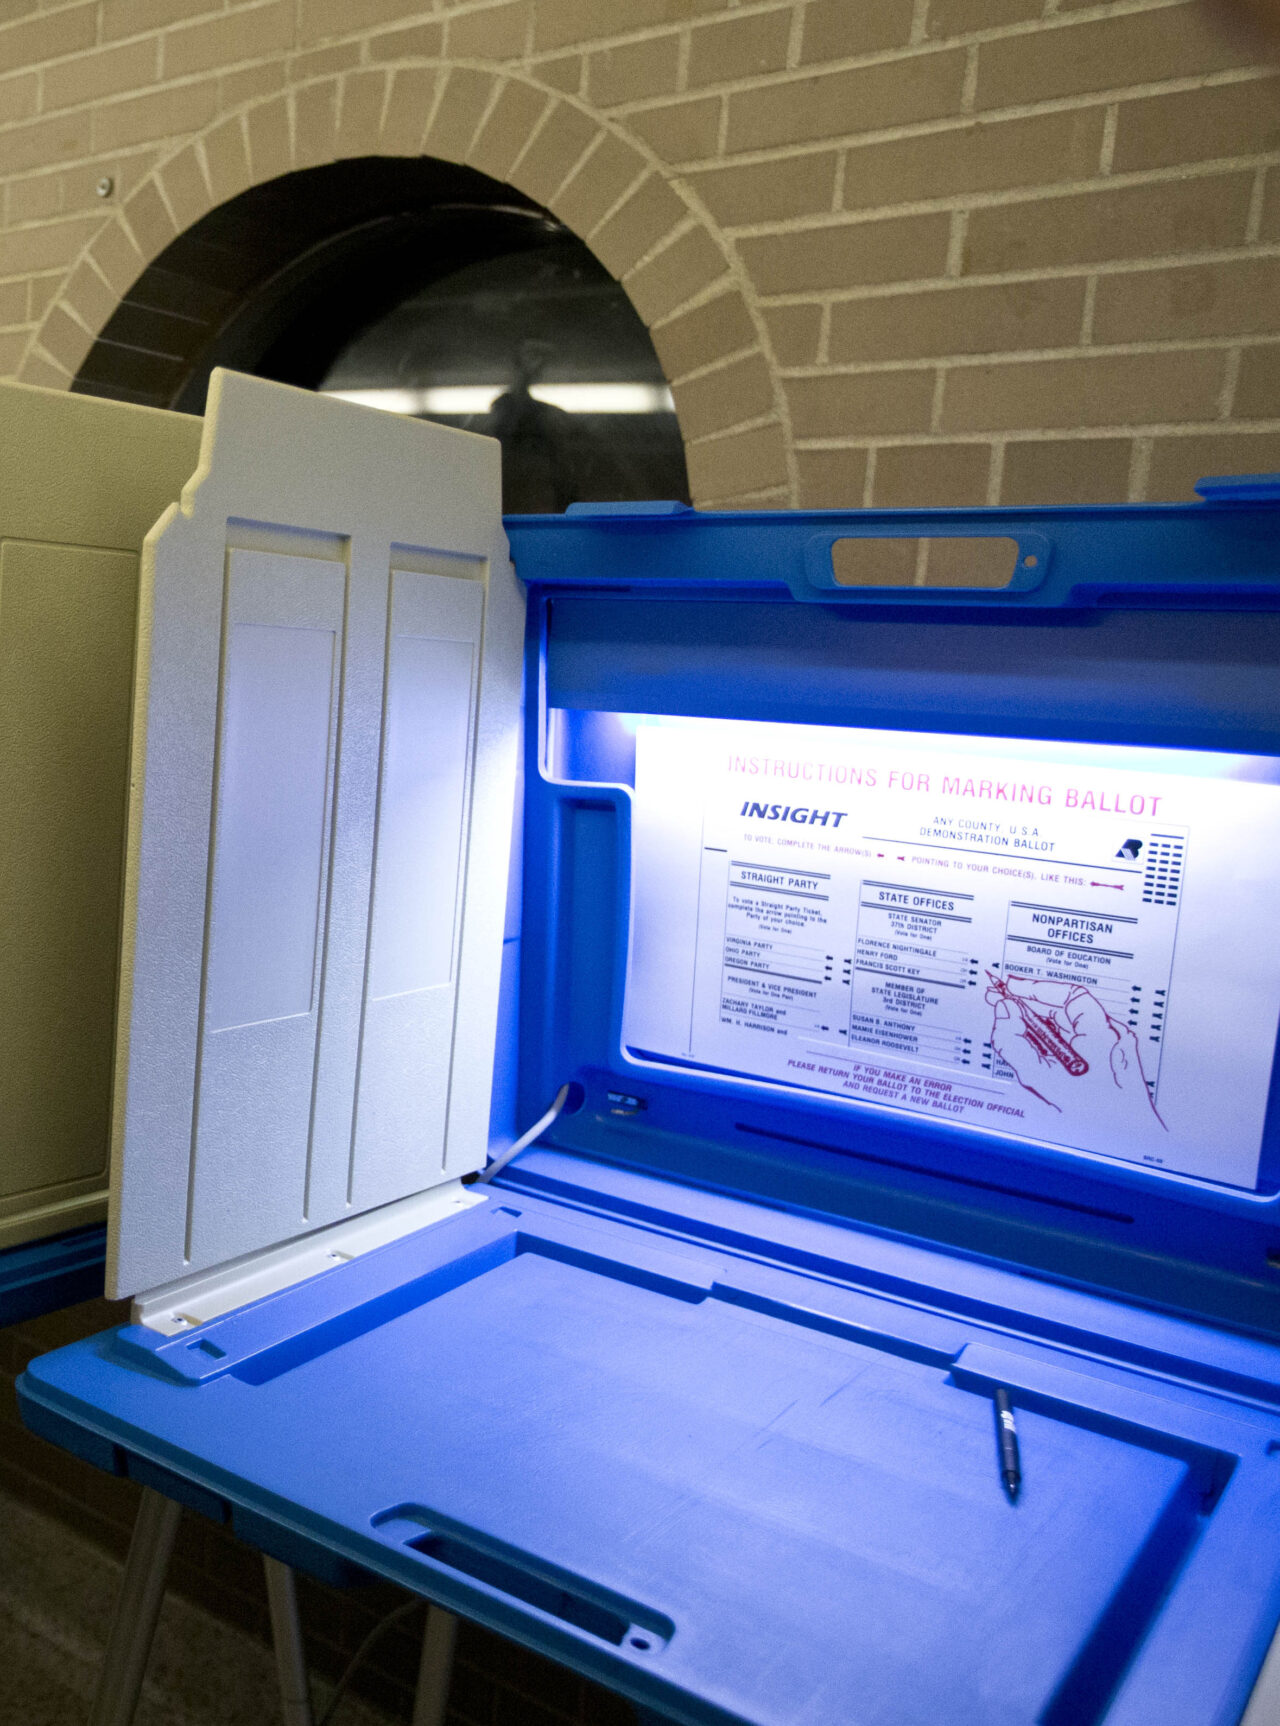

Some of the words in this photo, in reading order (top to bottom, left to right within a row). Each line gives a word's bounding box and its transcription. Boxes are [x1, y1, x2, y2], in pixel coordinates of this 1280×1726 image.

[728, 756, 877, 786] INSTRUCTIONS
[888, 771, 930, 792] FOR
[942, 776, 1052, 805] MARKING
[1065, 788, 1162, 816] BALLOT
[740, 802, 848, 827] INSIGHT
[933, 816, 954, 826] ANY
[744, 833, 752, 841] TO
[777, 838, 814, 850] COMPLETE
[818, 843, 830, 852] THE
[920, 826, 1008, 846] DEMONSTRATION
[1014, 838, 1055, 852] BALLOT
[912, 856, 949, 868] POINTING
[953, 861, 963, 870] TO
[966, 863, 989, 873] YOUR
[1040, 873, 1060, 882] LIKE
[741, 871, 784, 886] STRAIGHT
[788, 878, 818, 890] PARTY
[878, 891, 909, 905] STATE
[912, 896, 954, 912] OFFICES
[888, 912, 908, 922] STATE
[910, 916, 942, 926] SENATOR
[890, 921, 904, 929] 37th
[906, 923, 938, 934] DISTRICT
[1032, 913, 1113, 934] NONPARTISAN
[726, 937, 752, 946] VIRGINIA
[754, 942, 773, 950] PARTY
[1048, 928, 1094, 944] OFFICES
[726, 946, 740, 954] OHIO
[741, 950, 760, 958] PARTY
[856, 948, 878, 958] HENRY
[880, 952, 898, 961] FORD
[858, 938, 890, 949] FLORENCE
[892, 942, 936, 958] NIGHTINGALE
[1026, 946, 1052, 956] BOARD
[1054, 949, 1064, 957] OF
[1068, 952, 1111, 965] EDUCATION
[725, 956, 748, 966] OREGON
[750, 960, 770, 969] PARTY
[856, 958, 884, 970] FRANCIS
[885, 963, 906, 973] SCOTT
[907, 967, 920, 976] KEY
[1004, 964, 1034, 974] BOOKER
[1046, 970, 1098, 985] WASHINGTON
[728, 976, 759, 987] PRESIDENT
[768, 984, 781, 992] VICE
[783, 986, 817, 998] PRESIDENT
[872, 987, 892, 996] STATE
[894, 991, 938, 1005] LEGISLATURE
[884, 982, 914, 992] MEMBER
[722, 998, 749, 1008] ZACHARY
[751, 1002, 774, 1013] TAYLOR
[722, 1004, 748, 1014] MILLARD
[748, 1009, 778, 1020] FILLMORE
[896, 999, 926, 1010] DISTRICT
[744, 1020, 775, 1033] HARRISON
[852, 1014, 874, 1024] SUSAN
[884, 1020, 916, 1032] ANTHONY
[852, 1024, 873, 1034] MAMIE
[874, 1028, 918, 1042] EISENHOWER
[851, 1034, 880, 1046] ELEANOR
[882, 1040, 920, 1052] ROOSEVELT
[853, 1064, 861, 1072] IF
[864, 1066, 880, 1078] YOU
[883, 1070, 906, 1082] MAKE
[908, 1076, 921, 1086] AN
[924, 1079, 952, 1092] ERROR
[995, 1070, 1014, 1078] JOHN
[787, 1059, 816, 1072] PLEASE
[818, 1065, 850, 1078] RETURN
[852, 1073, 875, 1084] YOUR
[877, 1077, 909, 1092] BALLOT
[911, 1084, 922, 1094] TO
[925, 1088, 941, 1098] THE
[942, 1091, 984, 1108] ELECTION
[986, 1101, 1026, 1118] OFFICIAL
[842, 1080, 861, 1090] AND
[862, 1084, 900, 1099] REQUEST
[900, 1092, 908, 1100] A
[910, 1094, 929, 1106] NEW
[932, 1098, 965, 1114] BALLOT
